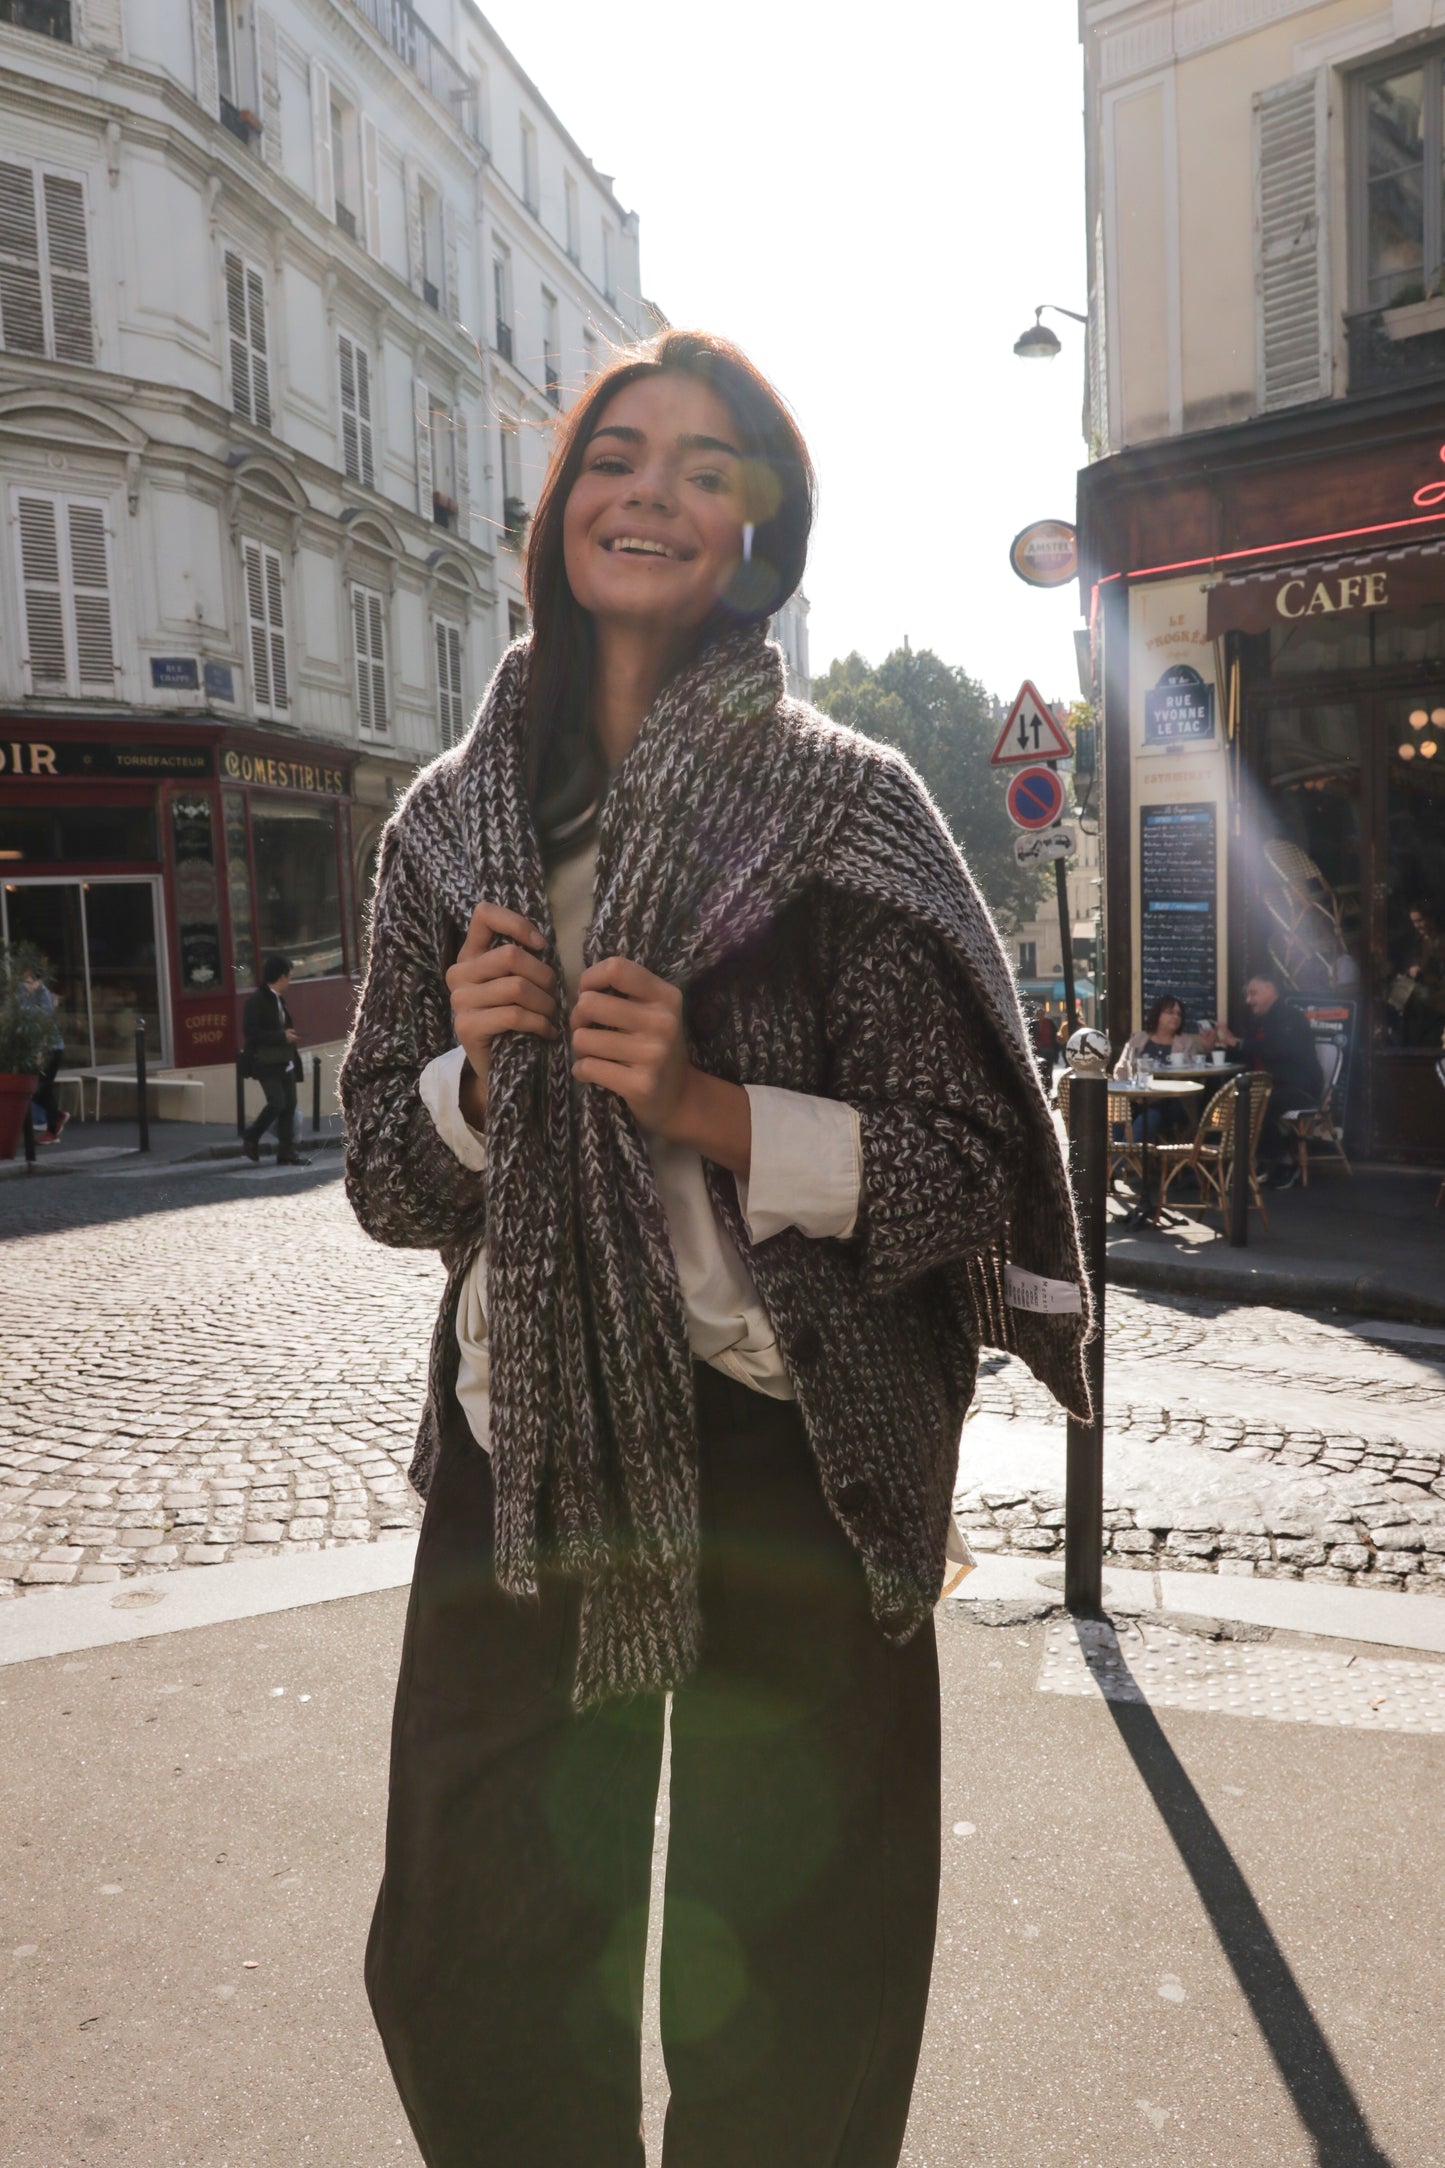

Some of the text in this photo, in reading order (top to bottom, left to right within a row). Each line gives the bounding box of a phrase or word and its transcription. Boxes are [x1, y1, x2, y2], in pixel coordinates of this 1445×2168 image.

[1276, 571, 1388, 618] CAFE
[1166, 694, 1191, 707] RUE
[1154, 706, 1205, 722] YVONNE
[1157, 720, 1200, 735] LE TAC
[0, 742, 58, 774] IR
[225, 751, 343, 793] COMESTIBLES
[185, 1013, 227, 1029] COFFEE
[192, 1030, 223, 1044] SHOP
